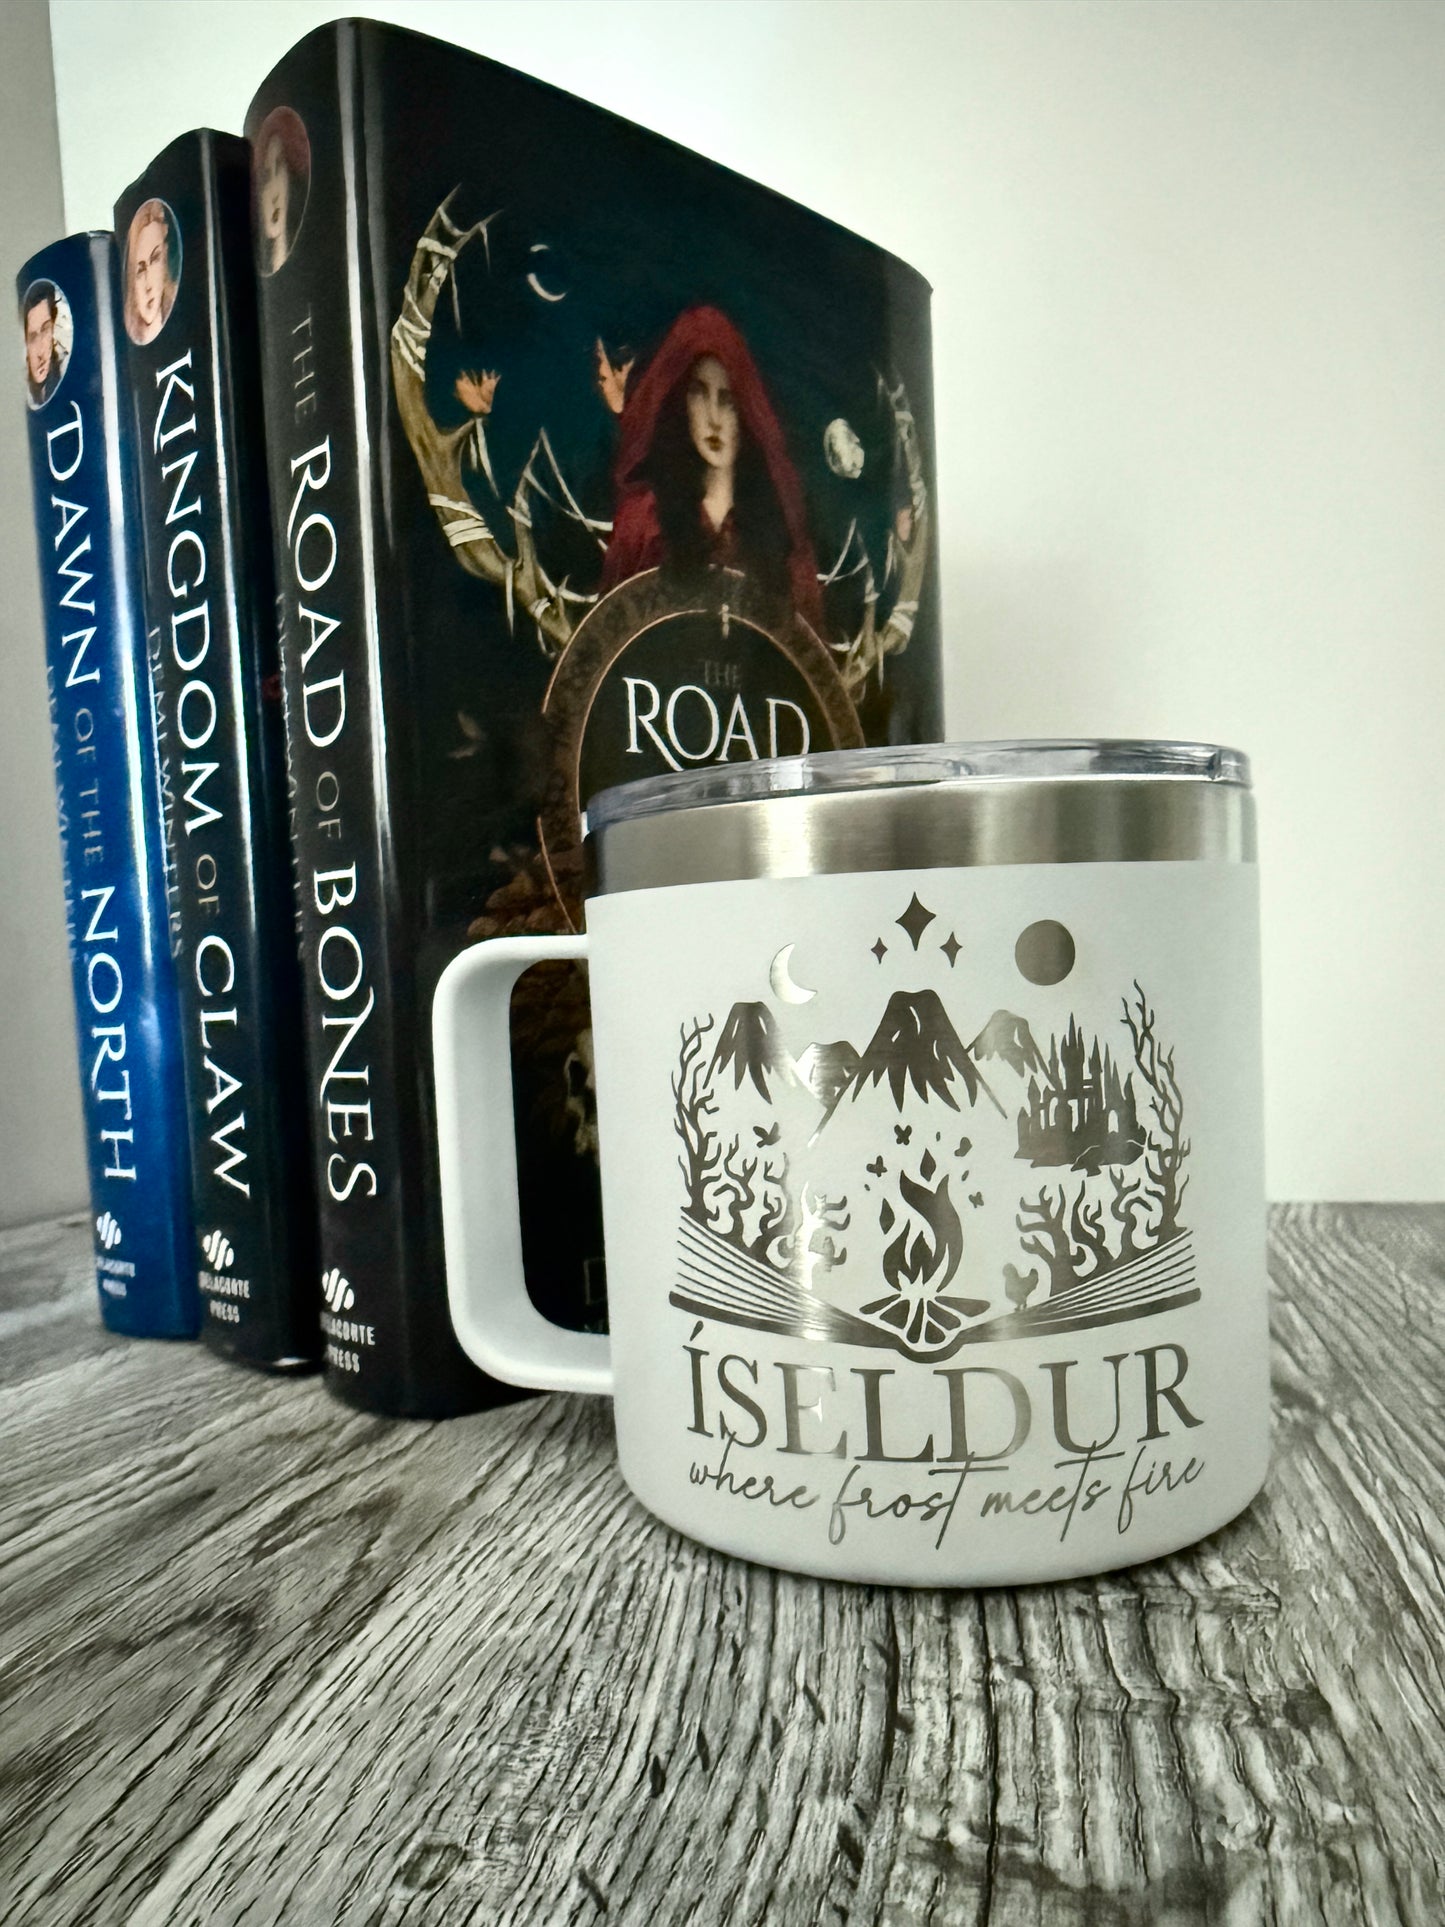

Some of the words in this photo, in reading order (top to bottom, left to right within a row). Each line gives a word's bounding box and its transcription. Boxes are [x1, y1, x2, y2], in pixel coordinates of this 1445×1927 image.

[291, 302, 317, 425] THE
[46, 400, 100, 689] DAWN
[154, 348, 224, 837] KINGDOM
[287, 435, 347, 748] ROAD
[74, 706, 97, 762] OF
[621, 676, 811, 772] ROAD
[79, 778, 104, 864] THE
[315, 770, 342, 839] OF
[195, 853, 220, 915] OF
[81, 885, 137, 1181] NORTH
[195, 934, 251, 1198] CLAW
[311, 861, 377, 1203] BONES
[682, 1320, 1204, 1463] ÍSELDUR
[688, 1430, 822, 1511] where
[828, 1450, 1009, 1550] frost
[980, 1440, 1126, 1543] meets
[1117, 1444, 1206, 1535] fire
